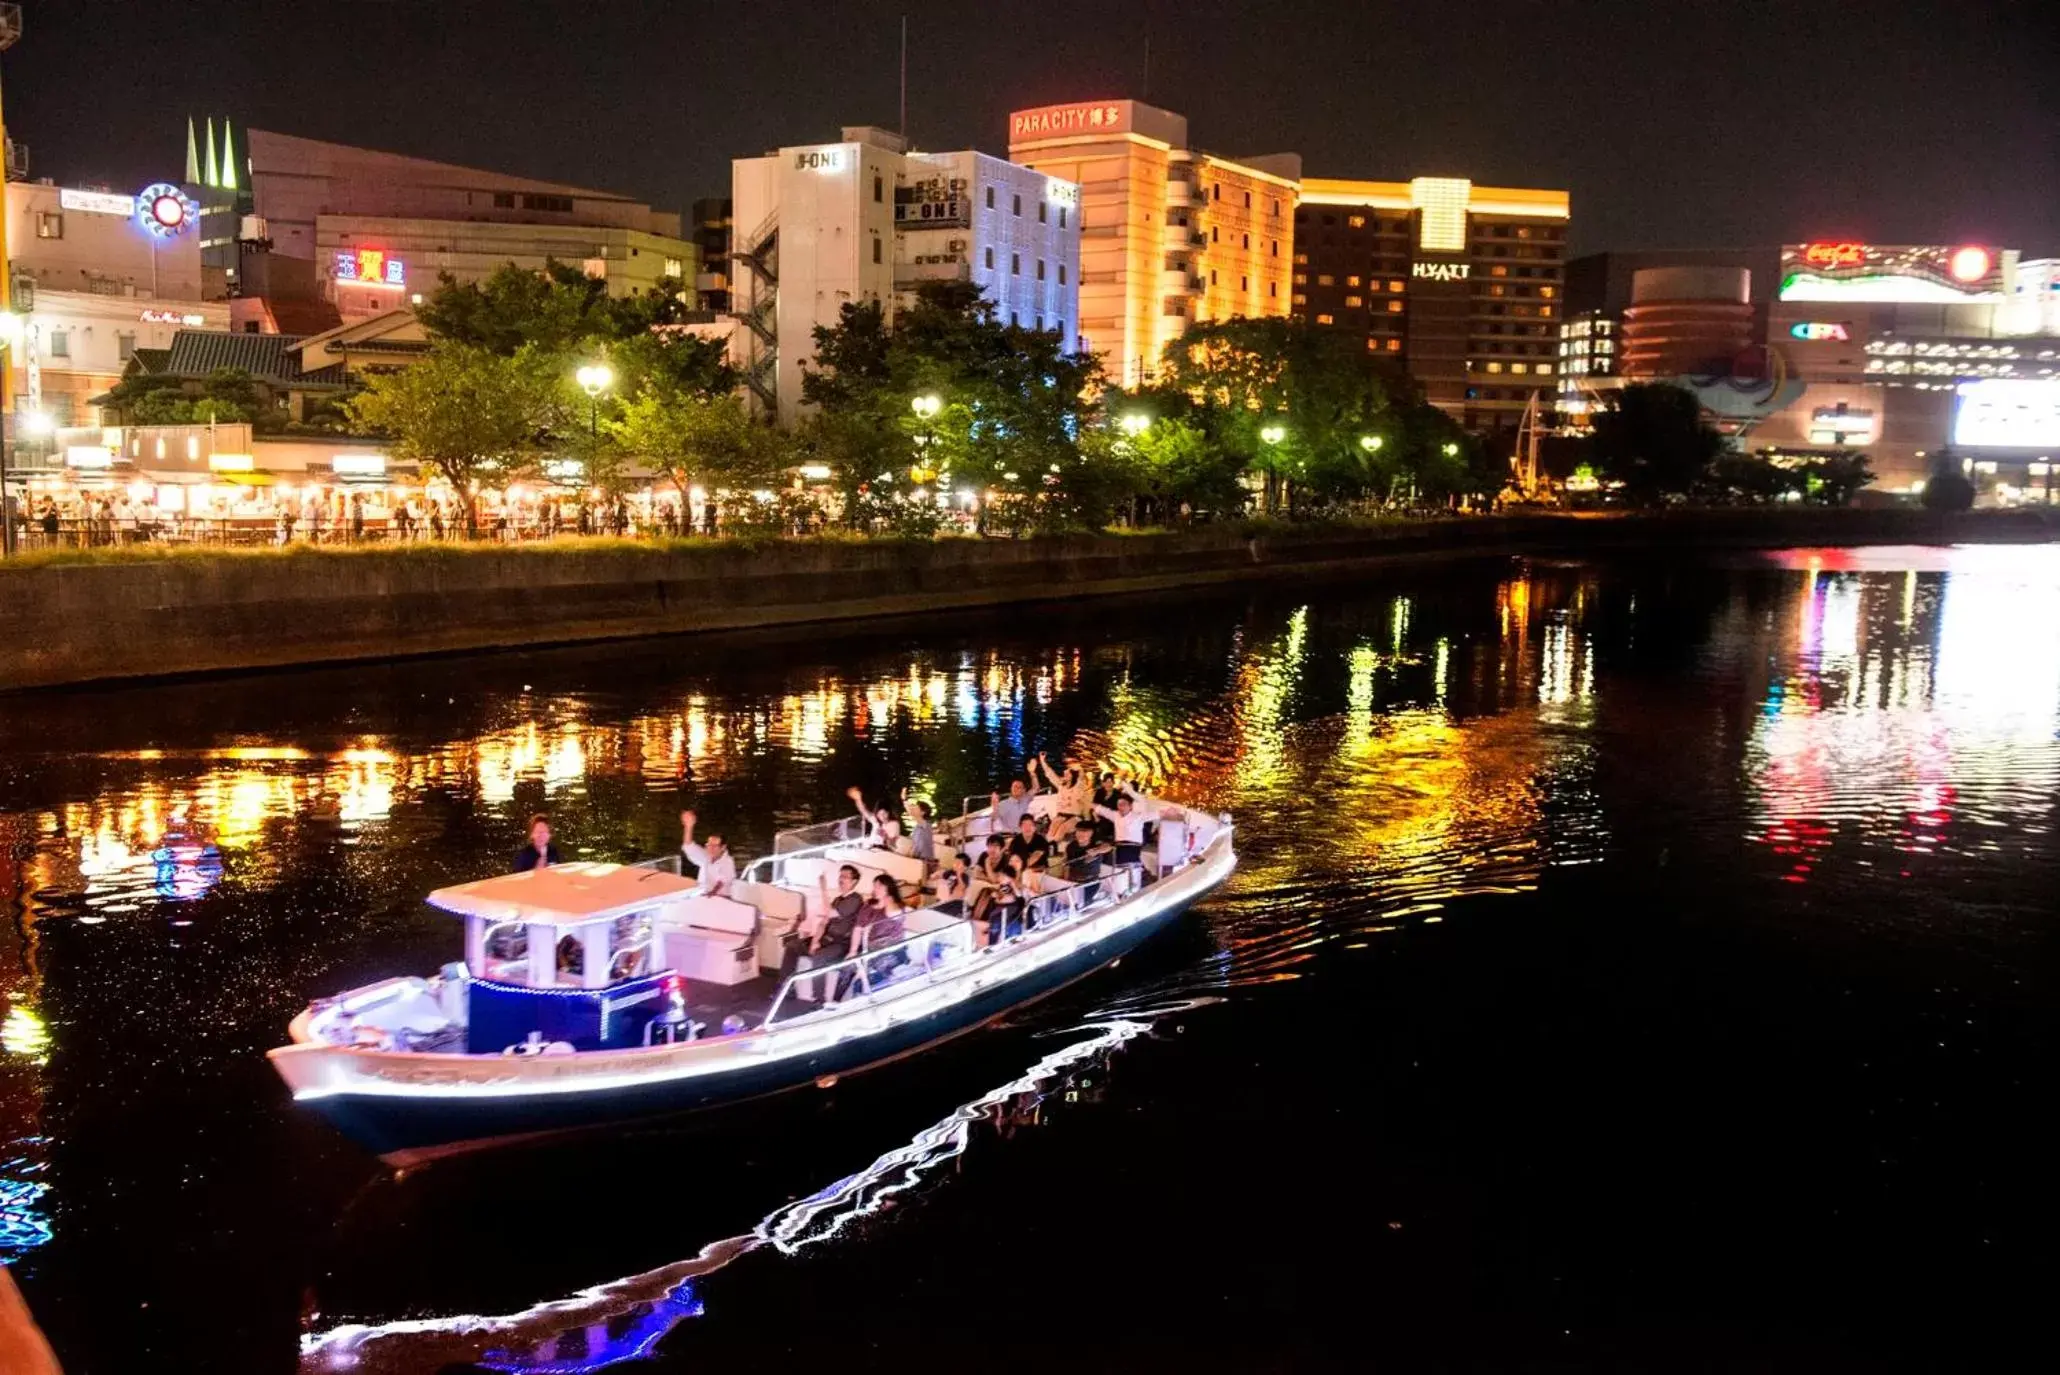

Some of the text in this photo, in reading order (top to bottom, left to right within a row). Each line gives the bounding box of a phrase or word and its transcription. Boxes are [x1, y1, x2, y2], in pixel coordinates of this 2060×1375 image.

[1015, 106, 1120, 135] PARACITY 博多
[1412, 263, 1470, 281] HYATT
